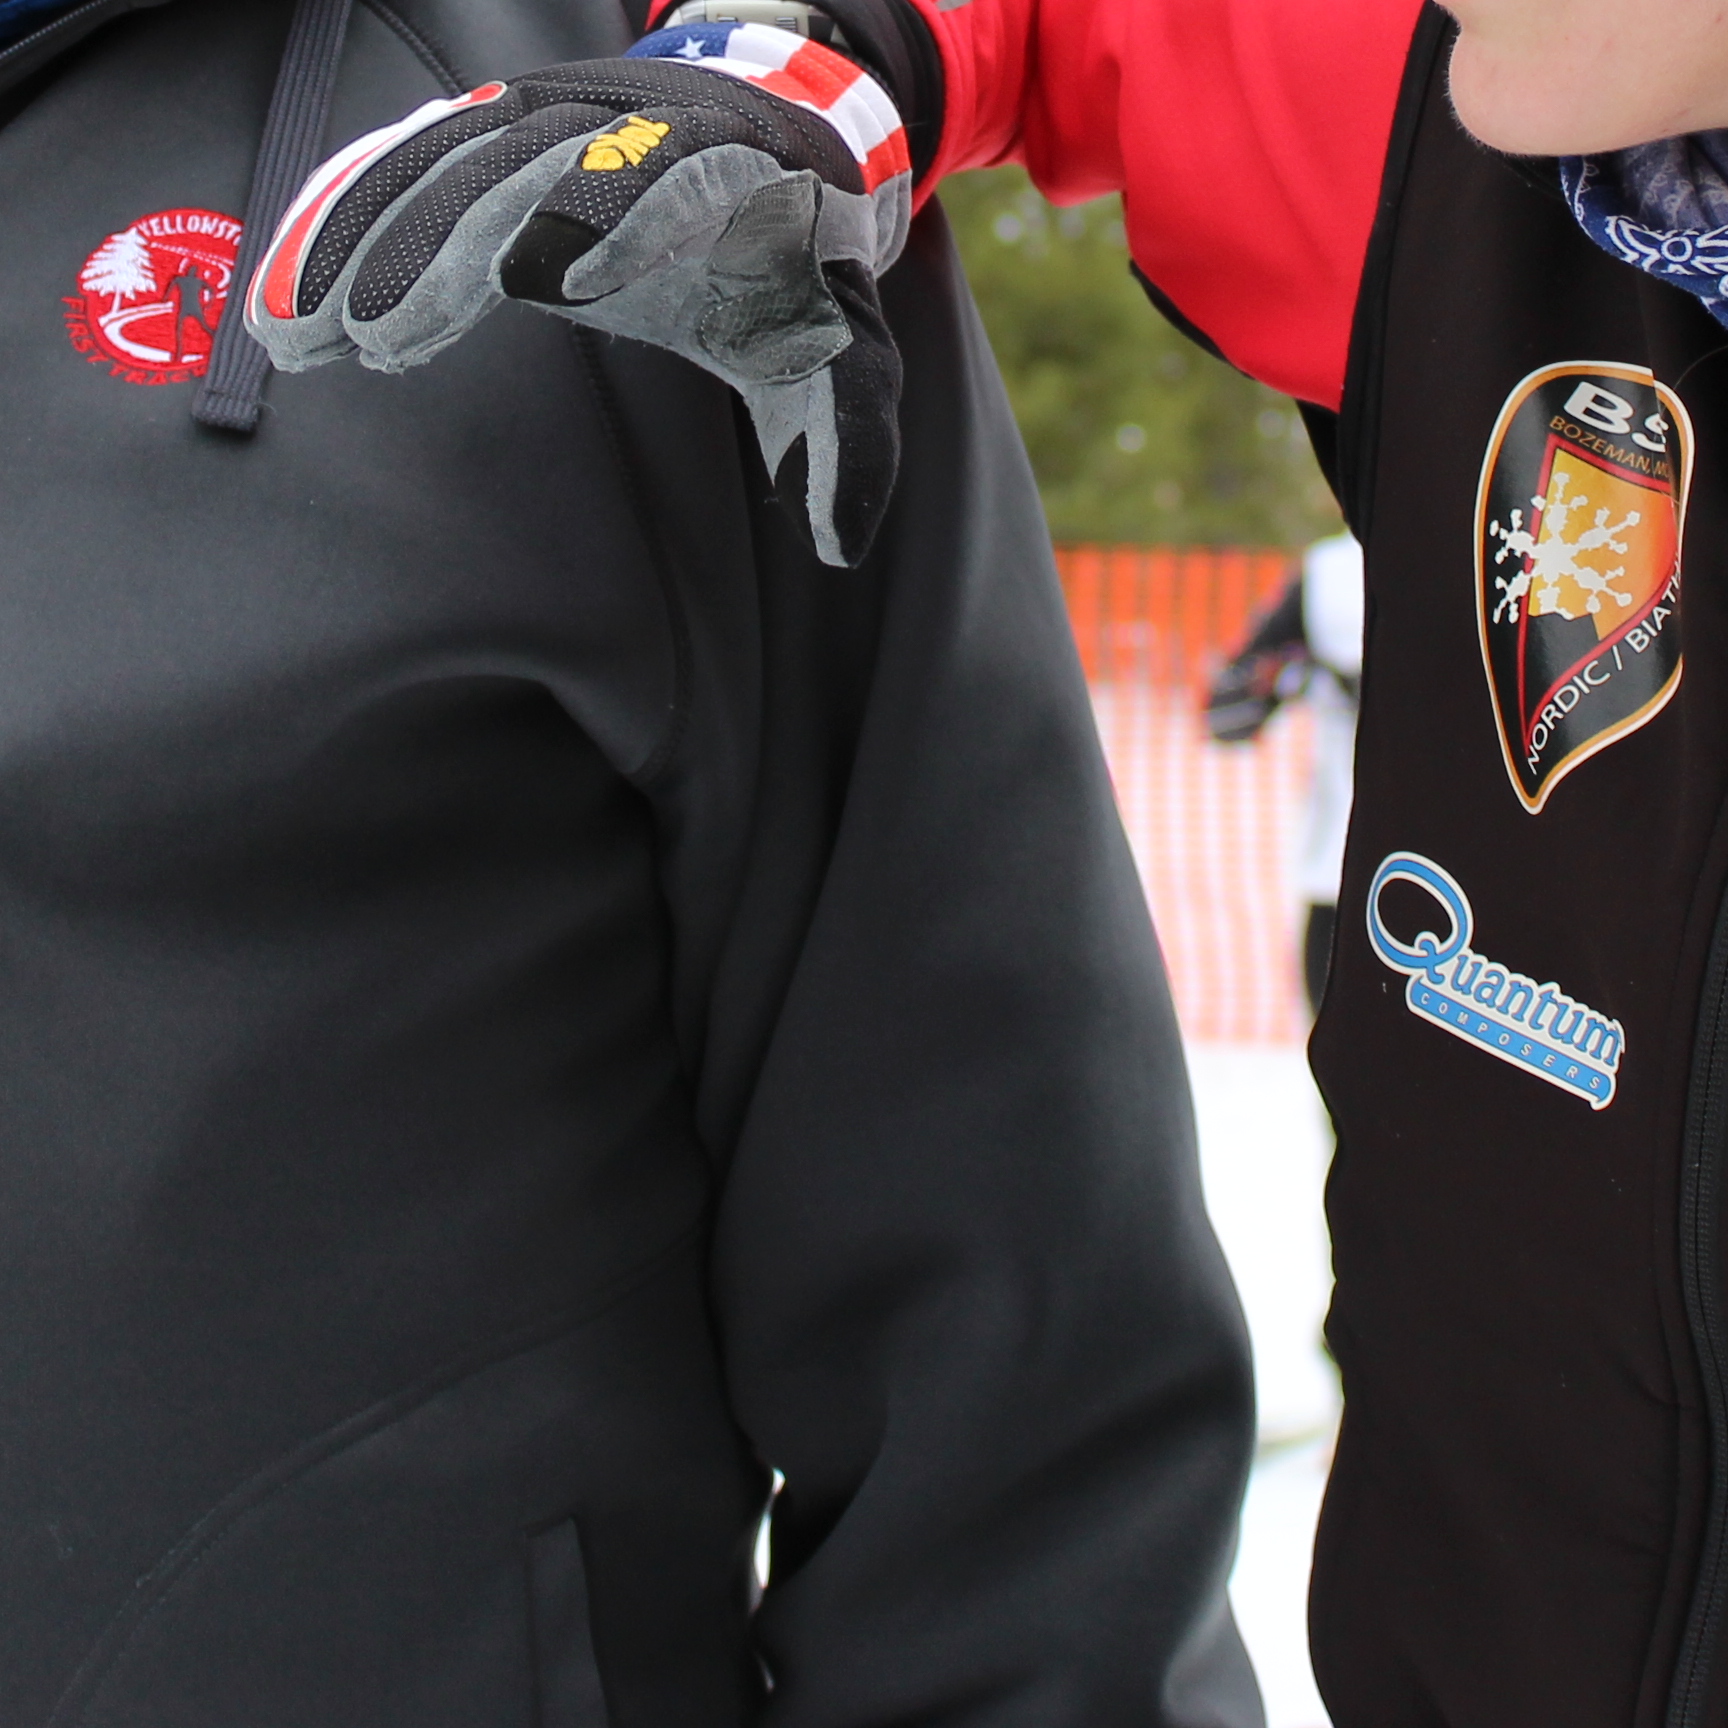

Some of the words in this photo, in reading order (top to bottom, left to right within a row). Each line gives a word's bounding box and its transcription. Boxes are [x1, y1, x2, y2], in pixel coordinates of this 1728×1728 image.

[61, 296, 109, 363] FIRST
[1527, 660, 1611, 775] NORDIC
[1369, 857, 1622, 1068] Quantum
[1421, 992, 1601, 1090] COMPOSERS
